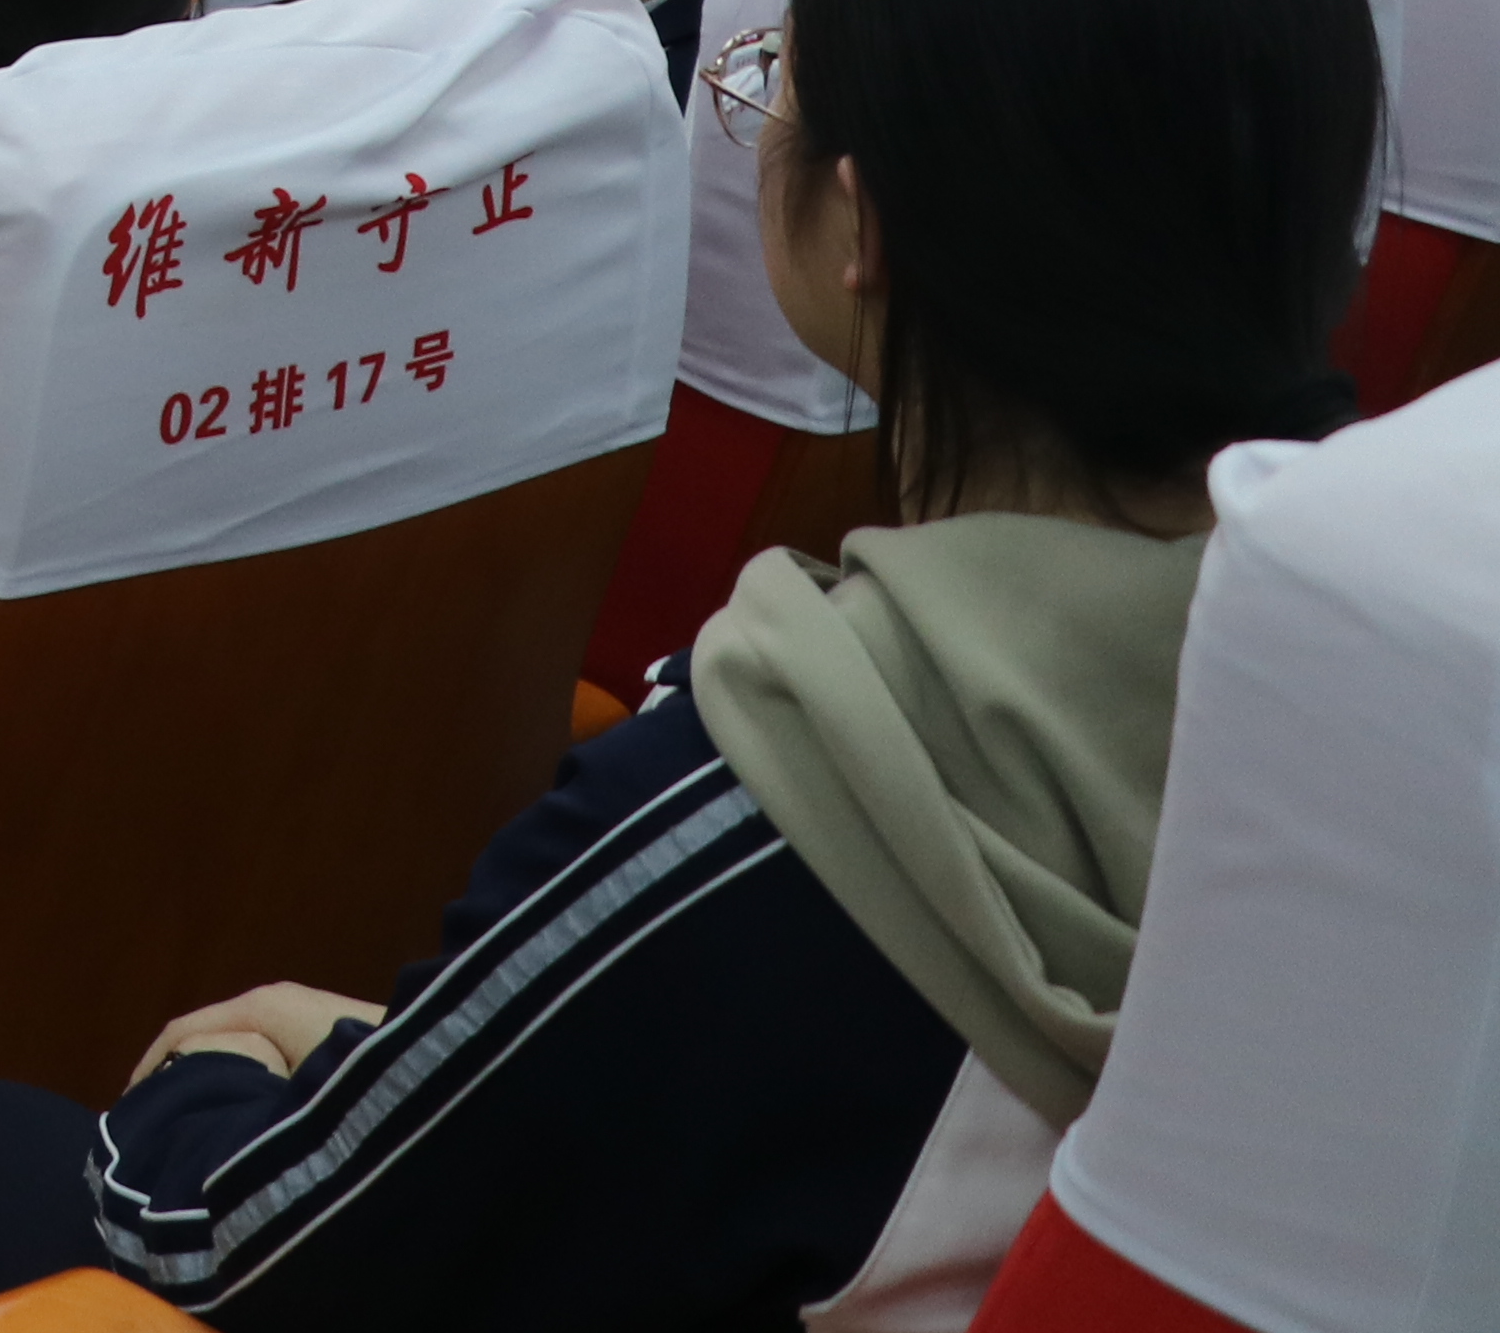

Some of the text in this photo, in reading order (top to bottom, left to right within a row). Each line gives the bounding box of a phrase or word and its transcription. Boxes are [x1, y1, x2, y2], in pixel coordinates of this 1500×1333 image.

[102, 151, 535, 320] 维新守正
[159, 329, 455, 446] 02排17号
